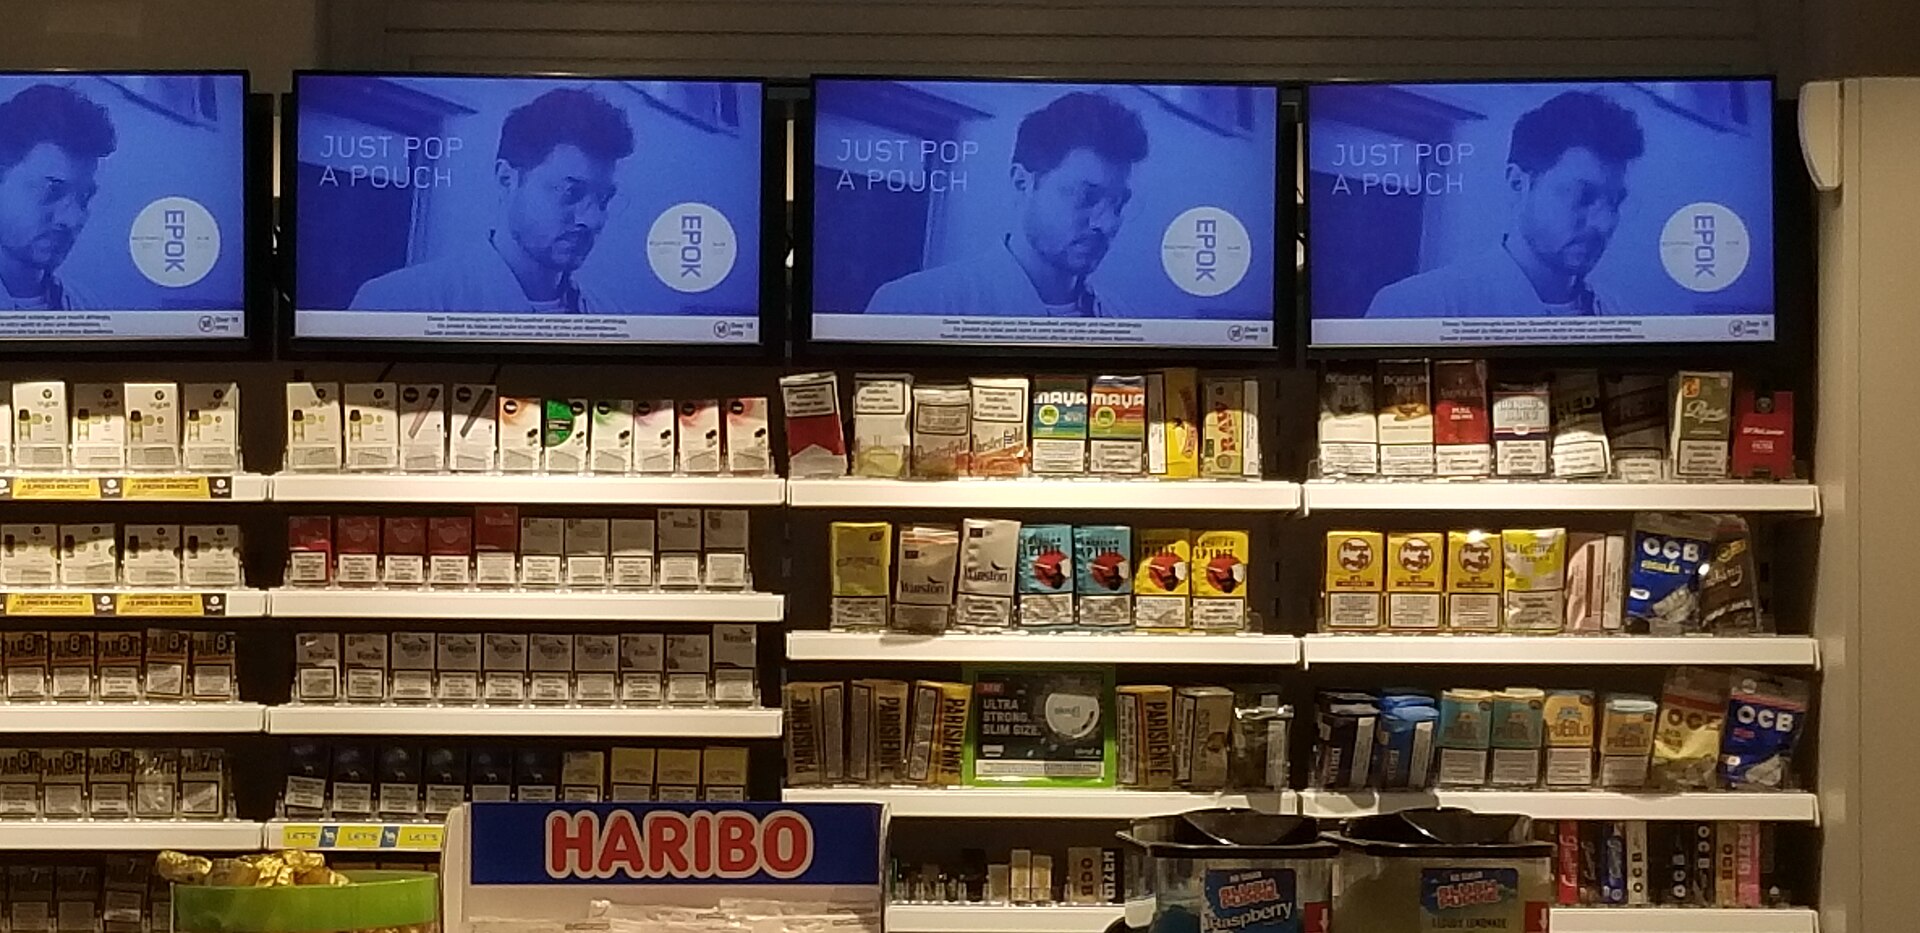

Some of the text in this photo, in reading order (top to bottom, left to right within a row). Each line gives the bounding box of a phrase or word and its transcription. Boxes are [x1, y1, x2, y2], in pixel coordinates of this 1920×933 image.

[320, 135, 463, 161] JUST POP
[836, 139, 980, 164] JUST POP
[1331, 143, 1474, 166] JUST POP
[320, 166, 453, 189] A POUCH
[836, 169, 969, 193] A POUCH
[1331, 172, 1463, 196] A POUCH
[164, 209, 186, 273] EPOK
[681, 214, 703, 279] EPOK
[1195, 219, 1216, 282] EPOK
[1693, 214, 1715, 278] EPOK
[1642, 537, 1700, 563] OCB
[901, 579, 945, 595] Winston
[964, 566, 1009, 583] Winston
[982, 698, 1020, 711] ULTRA
[982, 711, 1032, 723] STRONG.
[982, 723, 1042, 736] SLIM SIZE.
[1737, 705, 1794, 733] OCB
[1145, 701, 1173, 777] PARISIENNE
[287, 832, 317, 841] LET'S
[347, 832, 378, 842] LET'S
[409, 832, 437, 842] LET'S
[549, 813, 811, 876] HARIBO
[1697, 825, 1711, 870] OCB
[1631, 852, 1643, 893] OCB
[1671, 853, 1687, 898] OCB
[1722, 844, 1733, 881] OCB
[1208, 901, 1294, 930] Raspberry
